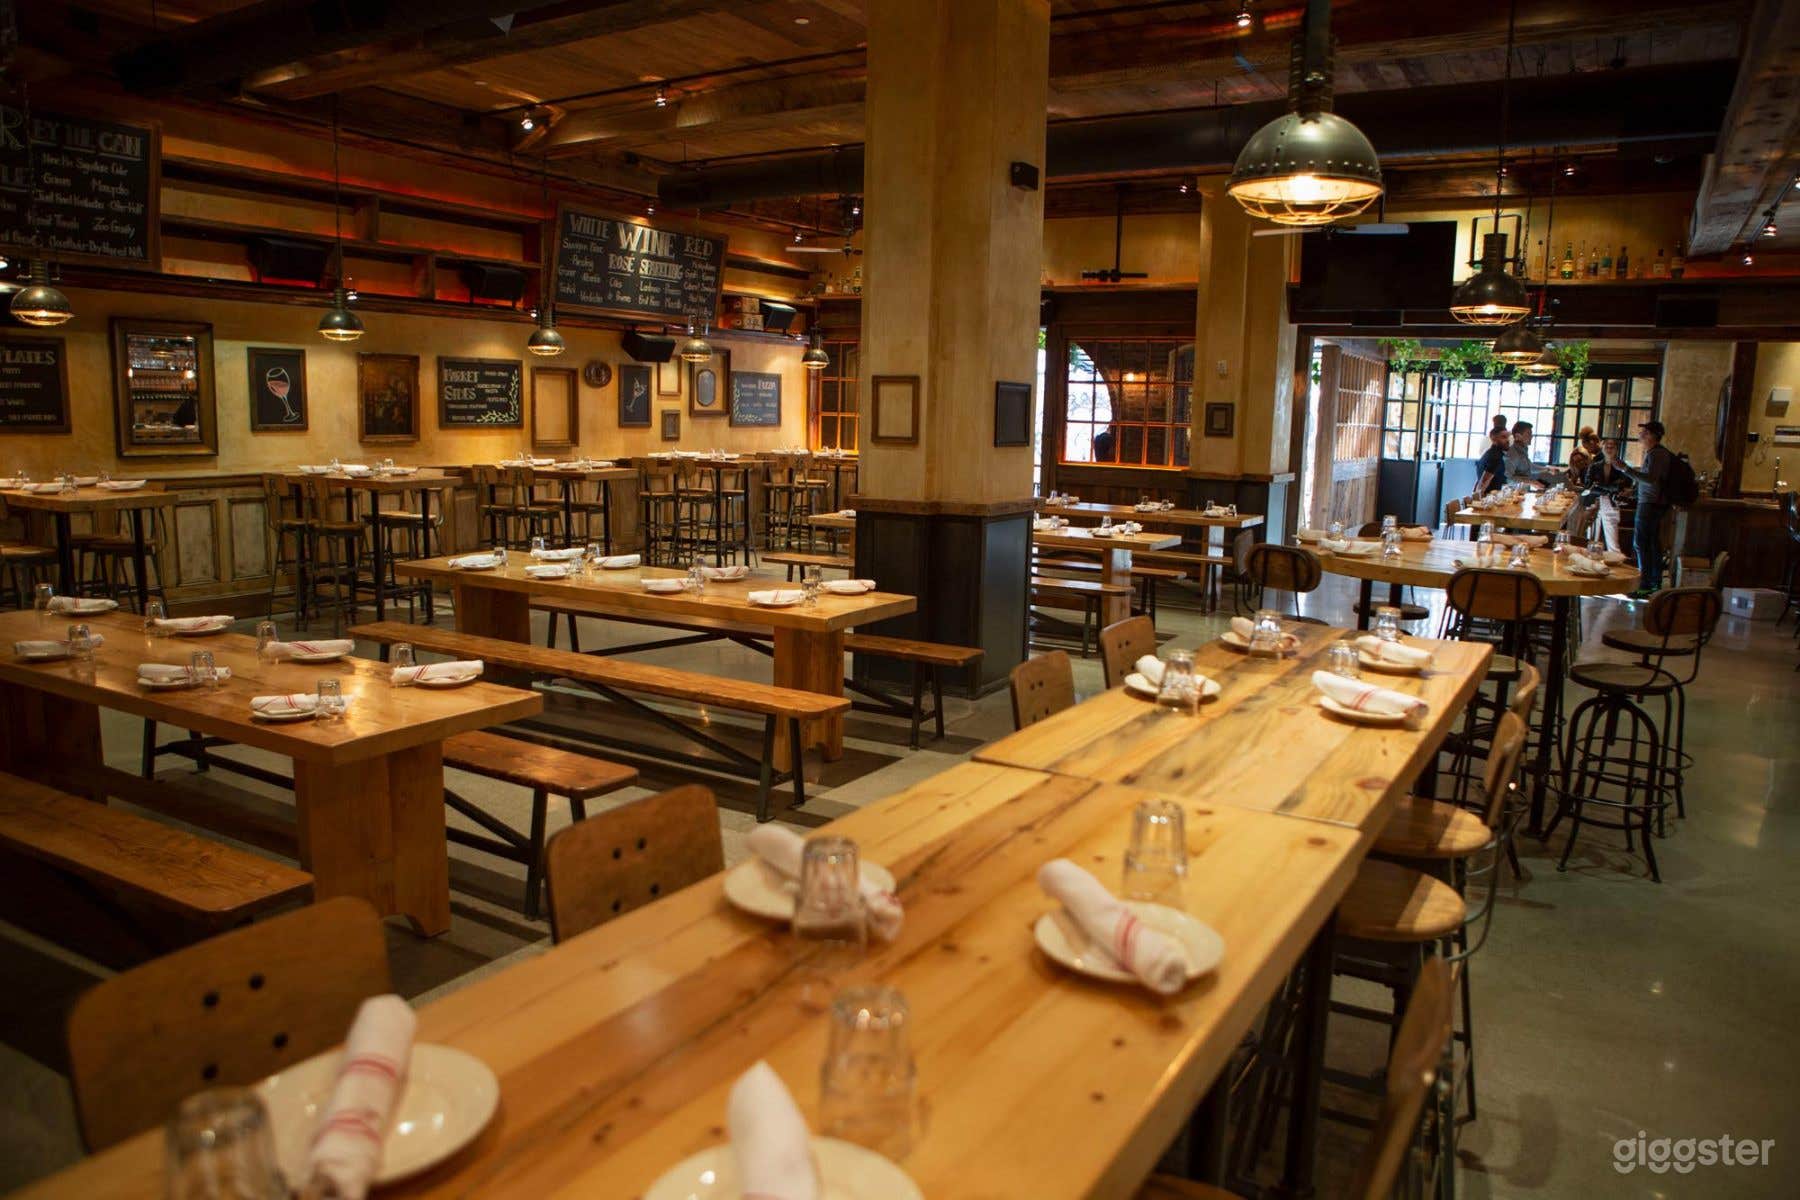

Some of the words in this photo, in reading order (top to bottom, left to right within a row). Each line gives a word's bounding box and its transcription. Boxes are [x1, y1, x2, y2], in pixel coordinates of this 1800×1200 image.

[569, 213, 610, 238] WHITE
[617, 222, 677, 259] WINE
[683, 236, 714, 257] RED
[444, 385, 477, 401] SIDES
